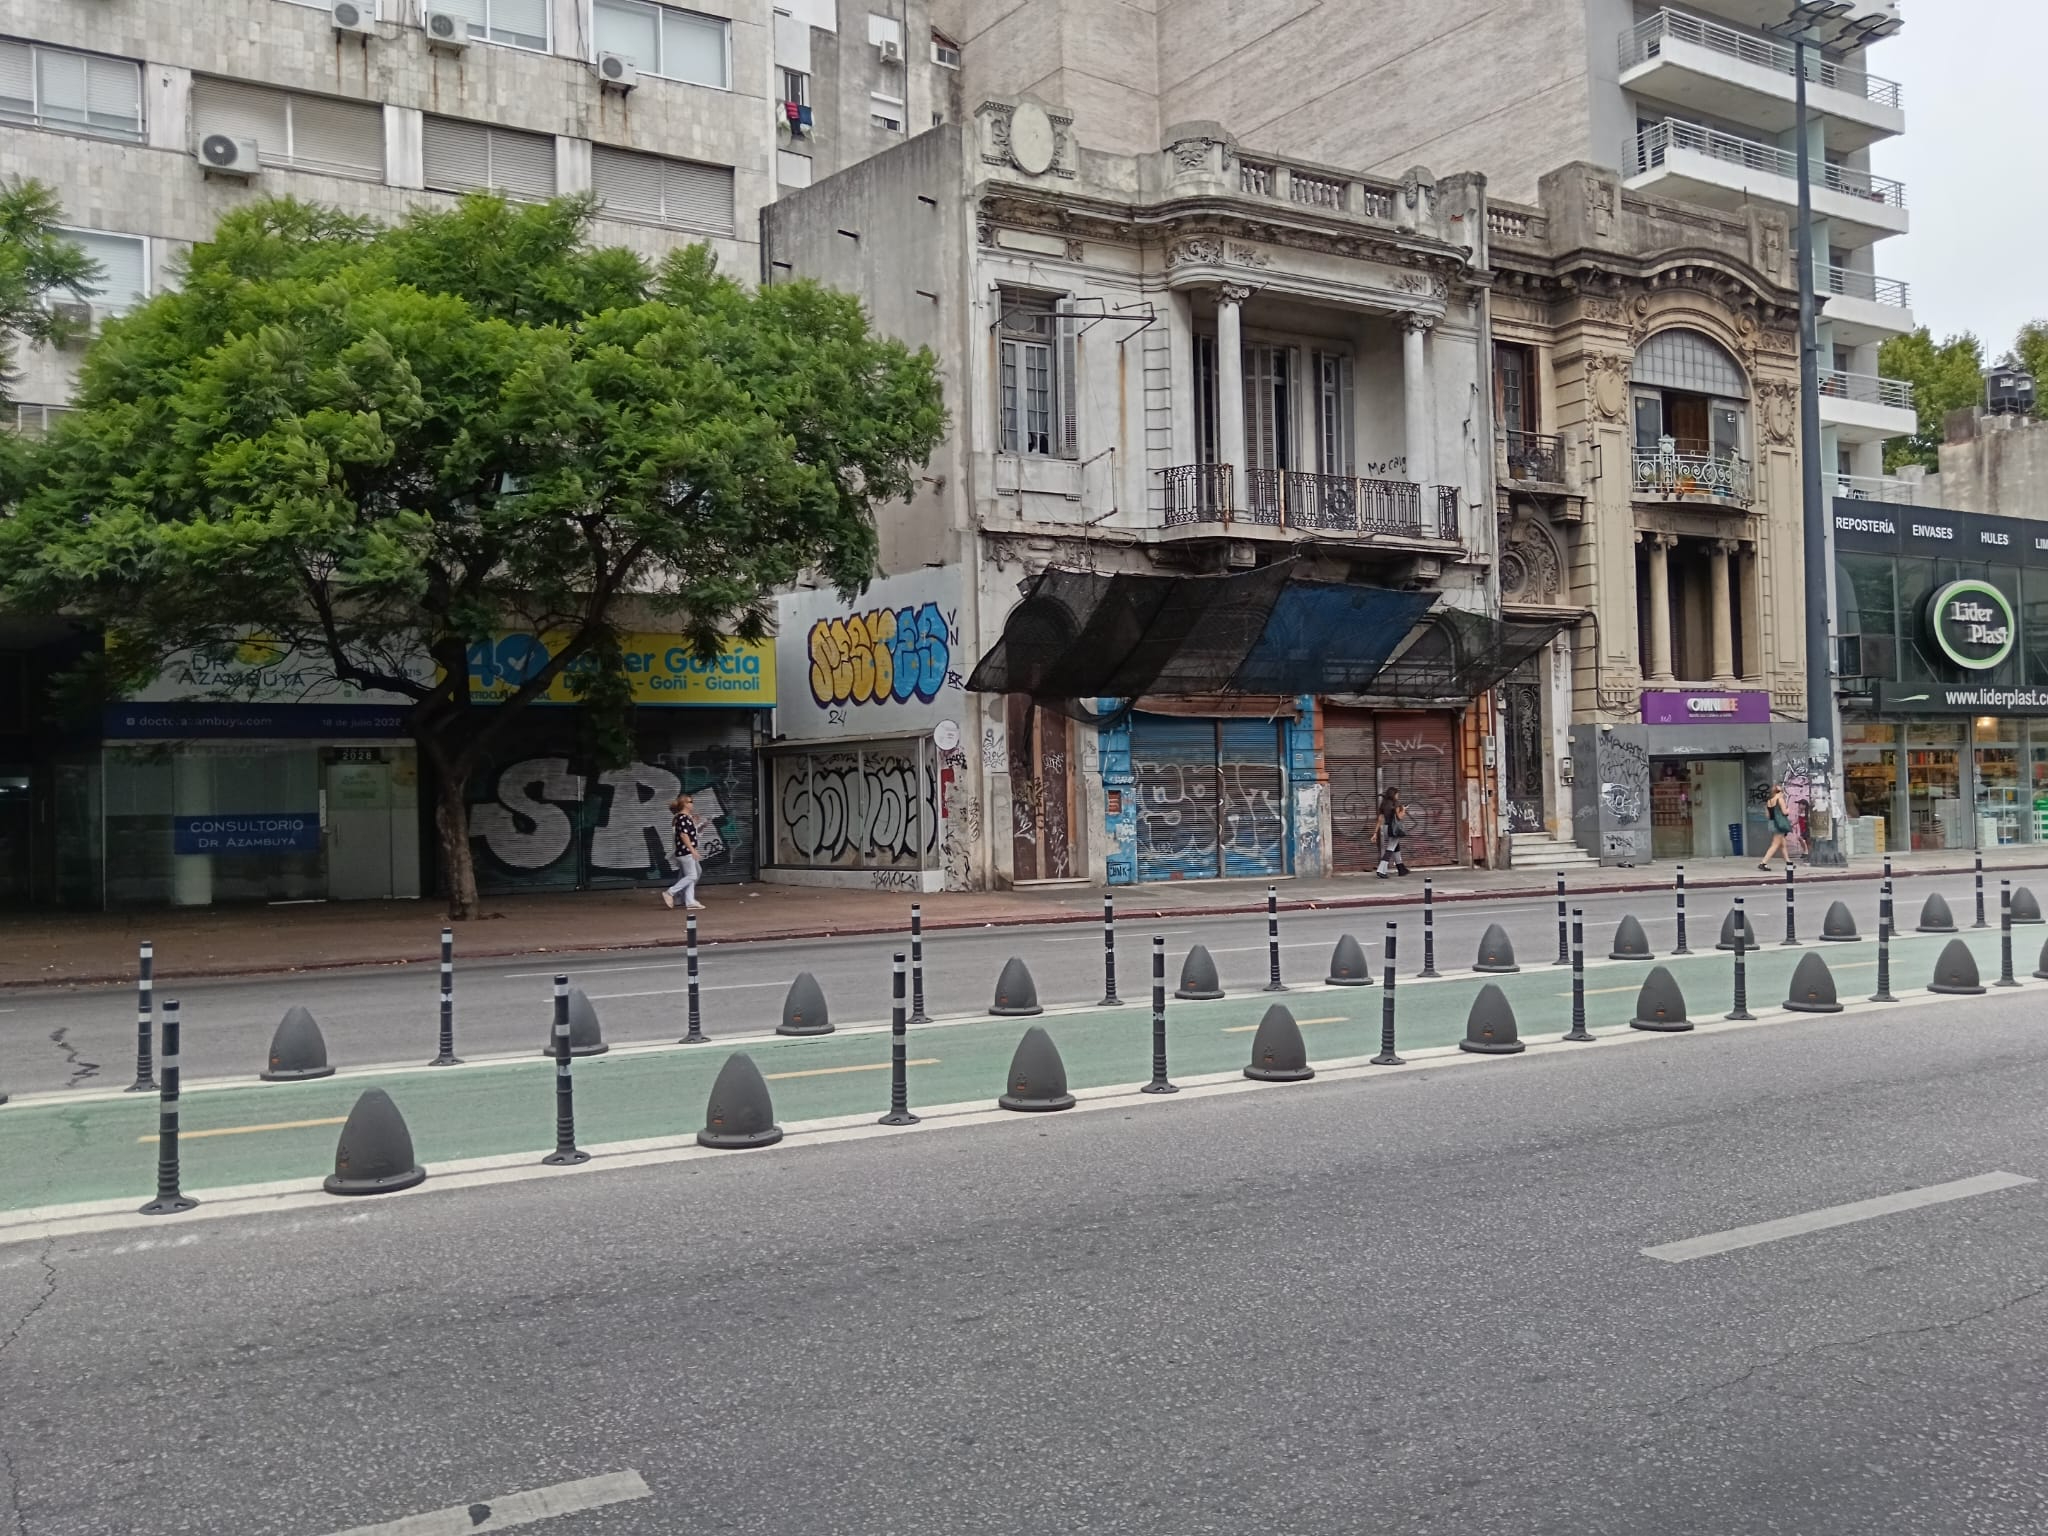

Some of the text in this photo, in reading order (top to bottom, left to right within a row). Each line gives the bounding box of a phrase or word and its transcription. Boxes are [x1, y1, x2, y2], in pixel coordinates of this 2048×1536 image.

[1835, 516, 1896, 534] REPOSTERÍA
[1912, 524, 1953, 540] ENVASES
[1980, 531, 2009, 546] HULES
[1967, 624, 2009, 644] Plast
[665, 647, 760, 675] García
[650, 675, 687, 691] Goñi
[706, 675, 760, 691] Gianoli
[1945, 688, 2048, 709] www.liderplast.c
[343, 752, 372, 760] 2028
[190, 819, 304, 833] CONSULTORIO
[226, 837, 296, 848] AZAMBUYA
